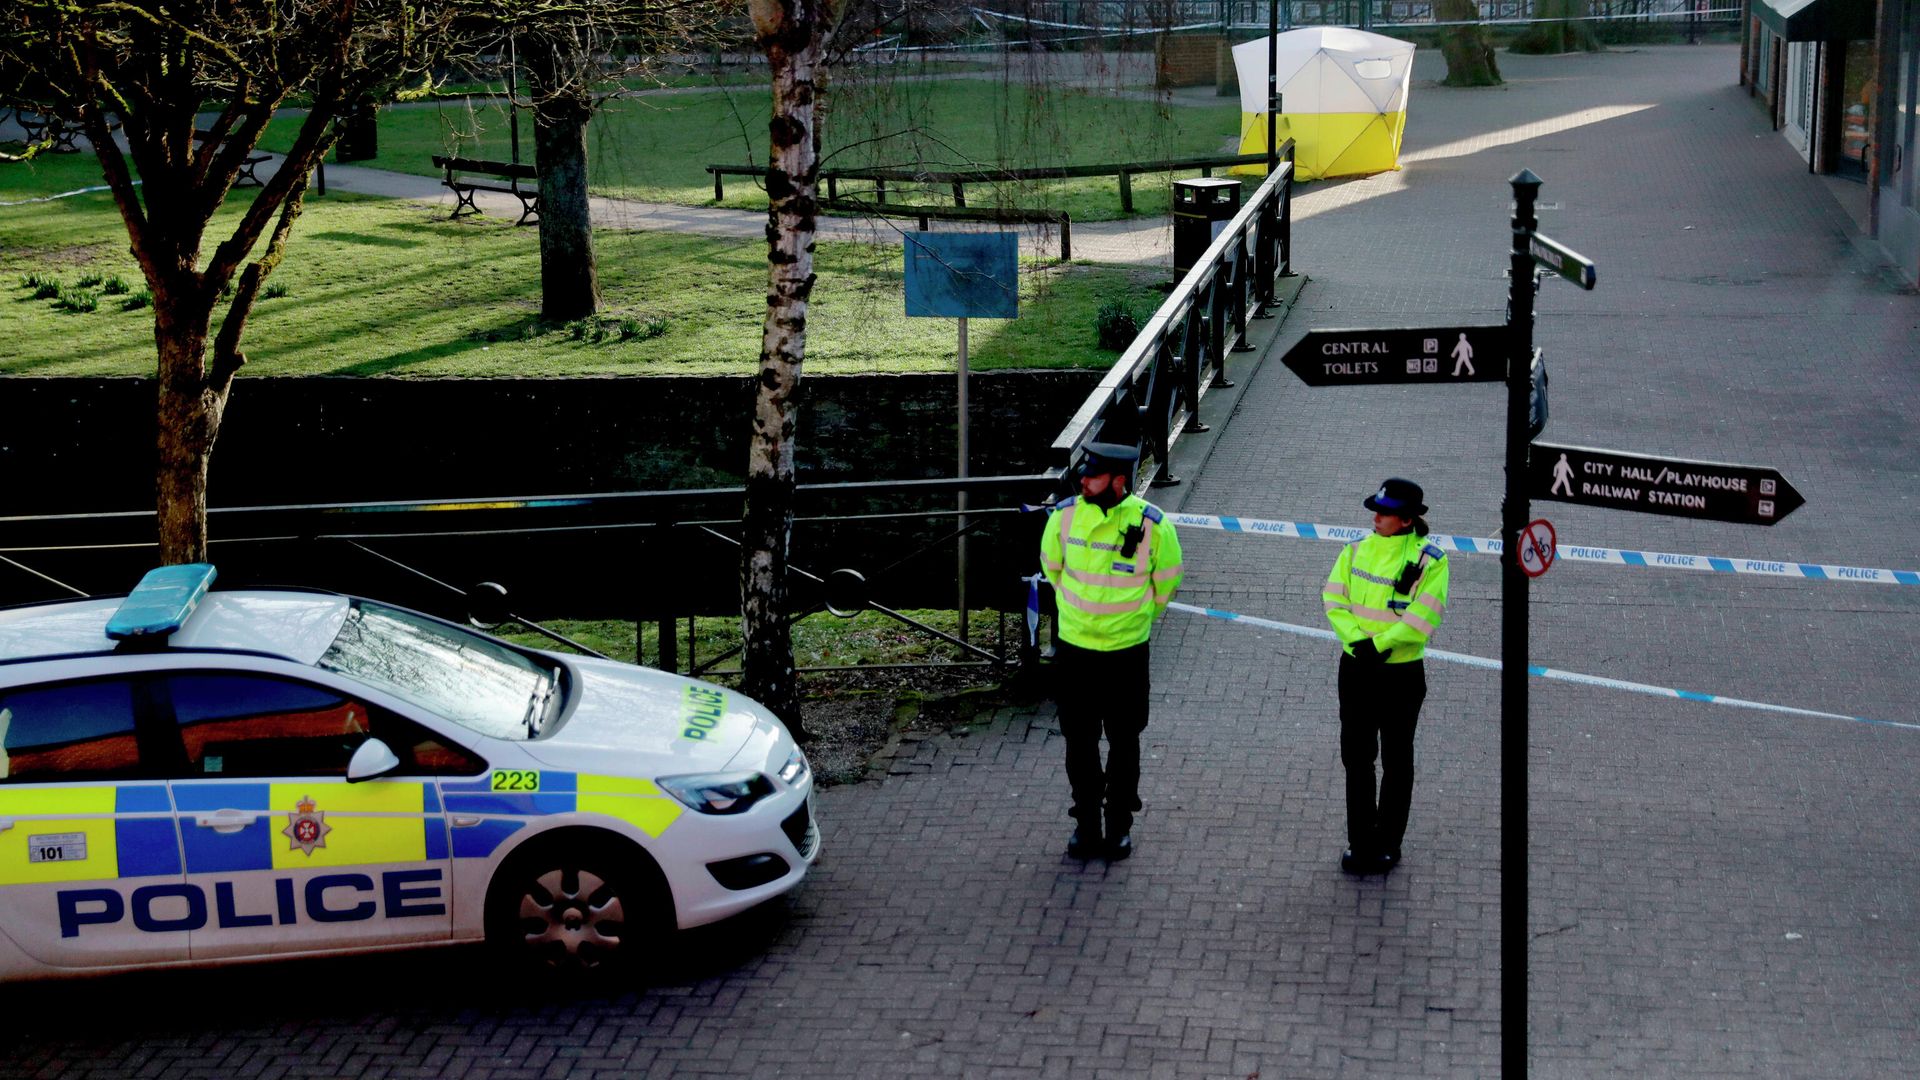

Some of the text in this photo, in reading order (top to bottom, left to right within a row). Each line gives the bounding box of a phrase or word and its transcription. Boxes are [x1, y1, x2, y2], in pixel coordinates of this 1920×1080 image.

[1322, 342, 1389, 355] CENTRAL
[1323, 362, 1379, 375] TOILETS
[1584, 461, 1748, 491] CITY HALL/PLAYHOUSE
[1582, 483, 1706, 509] RAILWAY STATION
[1251, 521, 1286, 532] POLICE
[1327, 527, 1363, 538] POLICE
[1570, 547, 1879, 580] POLICE POLICE POLICE POLICE
[684, 686, 723, 742] POLICE
[493, 771, 538, 791] 223
[40, 846, 63, 860] 101
[57, 868, 446, 938] POLICE
